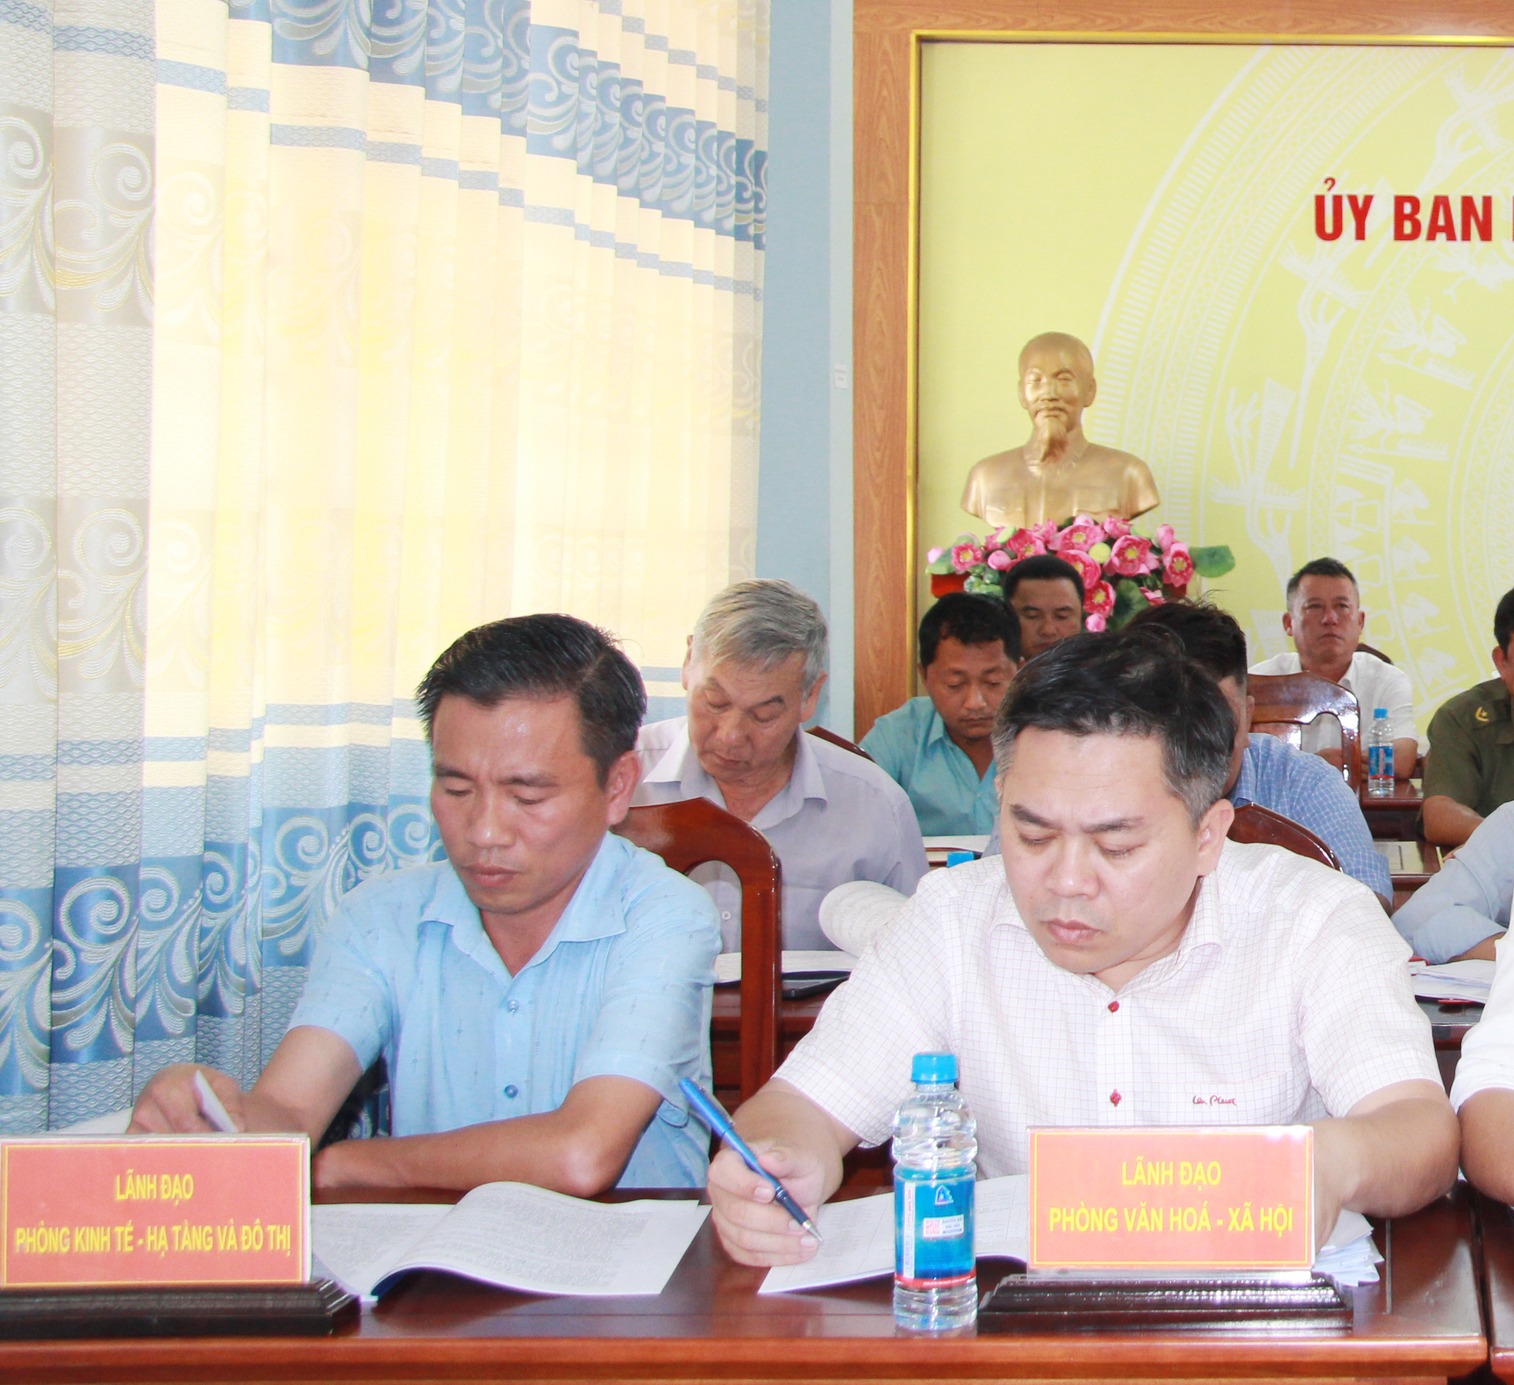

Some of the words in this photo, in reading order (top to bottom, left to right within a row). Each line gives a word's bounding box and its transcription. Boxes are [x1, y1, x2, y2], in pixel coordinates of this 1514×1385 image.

[1314, 177, 1375, 243] ỦY
[1393, 193, 1494, 243] BAN
[115, 1170, 157, 1201] LÃNH
[160, 1174, 194, 1206] ĐẠO
[1122, 1157, 1174, 1186] LÃNH
[1179, 1161, 1222, 1192] ĐẠO
[15, 1220, 71, 1254] PHÒNG
[74, 1226, 111, 1252] KINH
[147, 1225, 169, 1257] HẠ
[217, 1218, 239, 1250] VÀ
[241, 1218, 264, 1250] ĐÔ
[267, 1225, 291, 1257] THỊ
[1049, 1201, 1119, 1233] PHÒNG
[1123, 1202, 1164, 1232] VĂN
[1169, 1201, 1212, 1232] HOÁ
[1228, 1202, 1255, 1232] XÃ
[1260, 1203, 1294, 1238] HỘI
